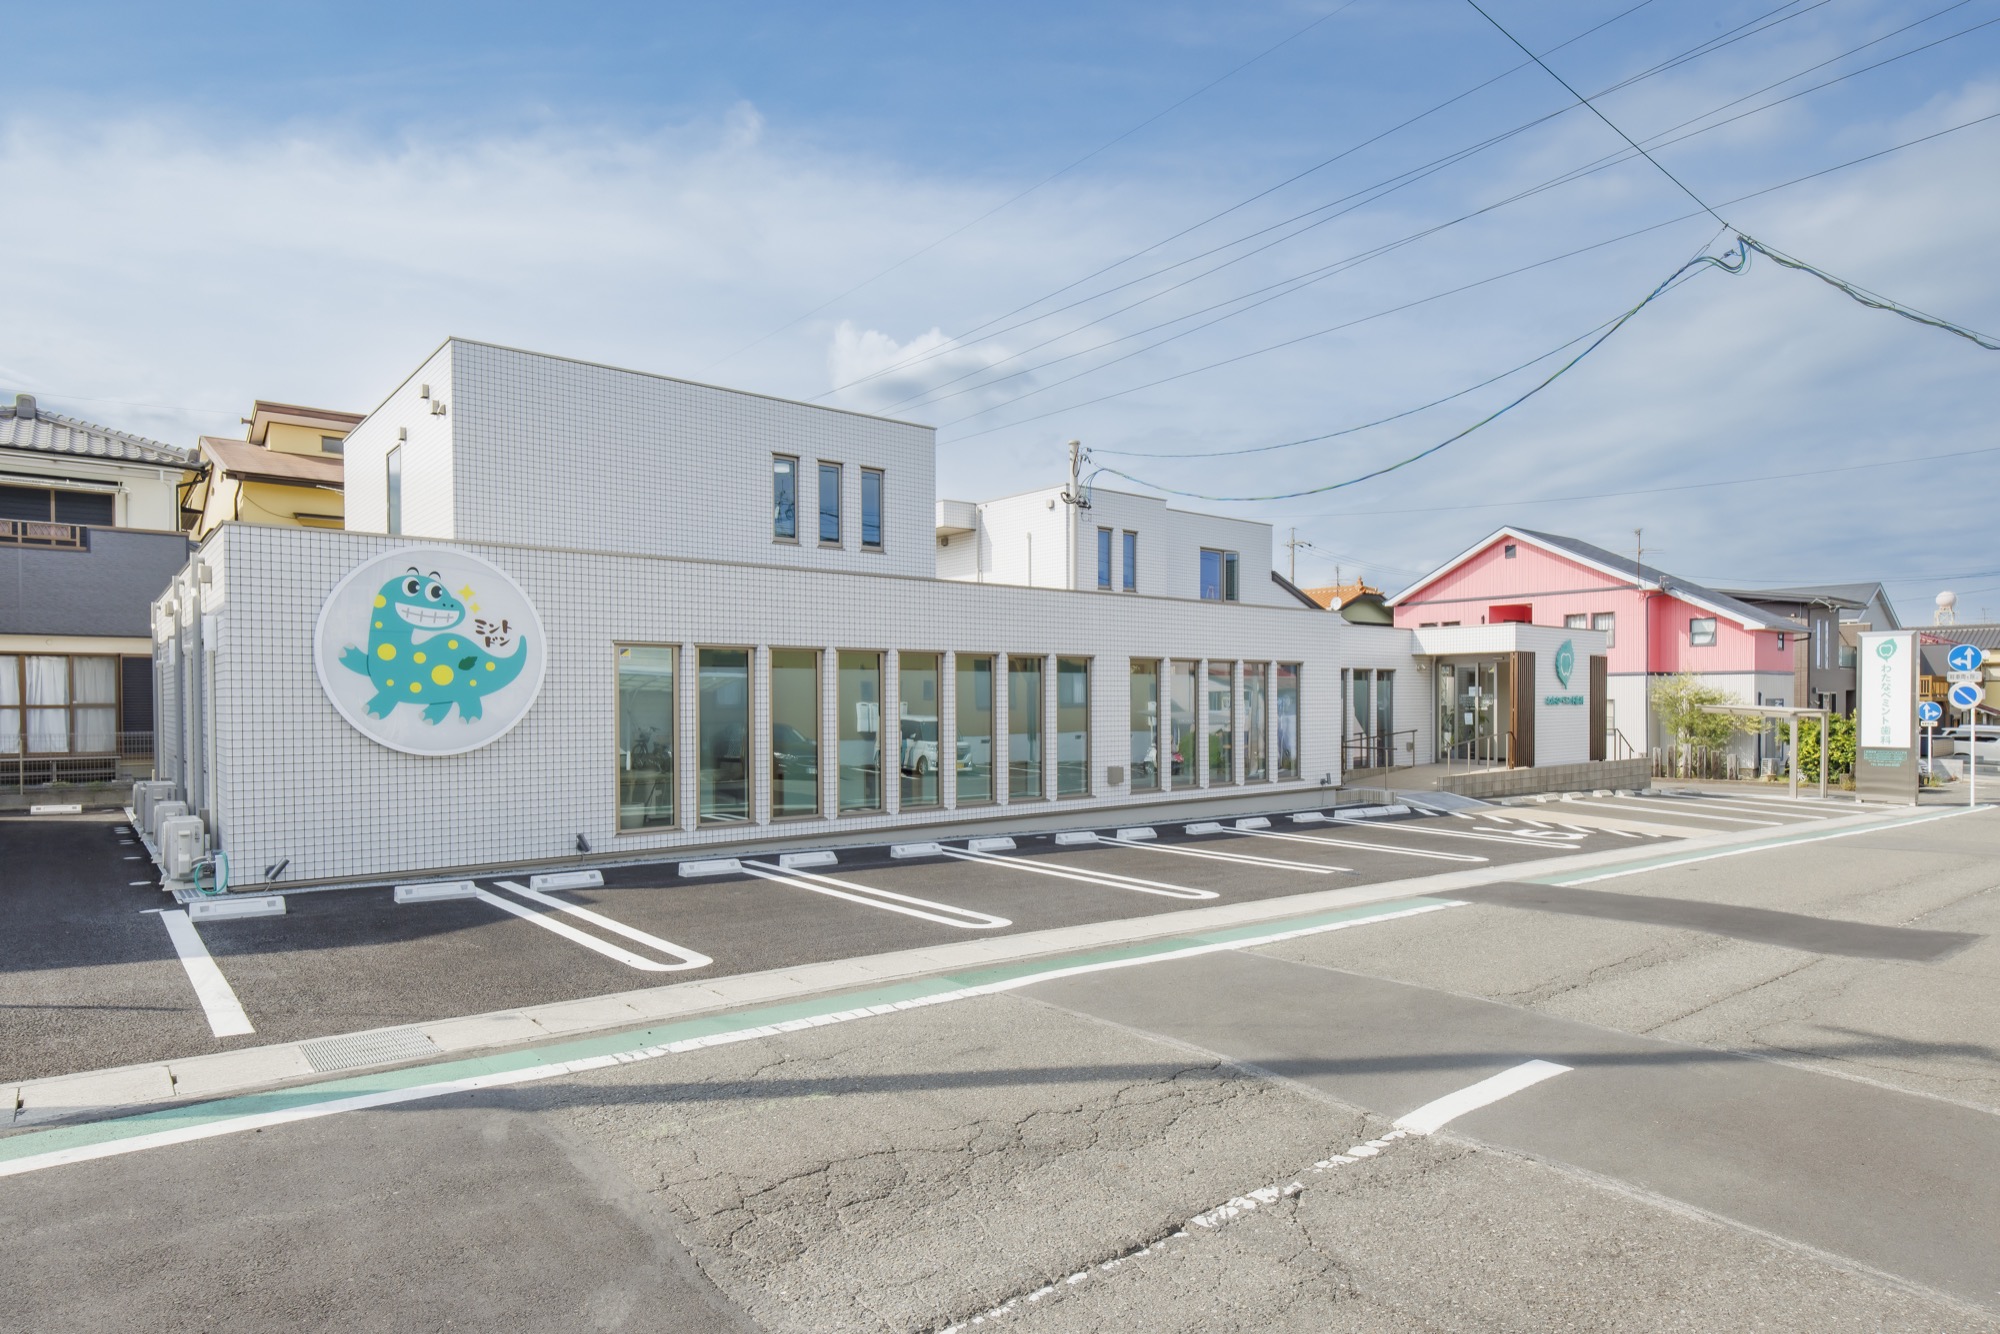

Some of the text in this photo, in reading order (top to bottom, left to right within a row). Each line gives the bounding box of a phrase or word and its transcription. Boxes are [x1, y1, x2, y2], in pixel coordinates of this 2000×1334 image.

[474, 618, 512, 635] ミント
[484, 635, 511, 648] ドン
